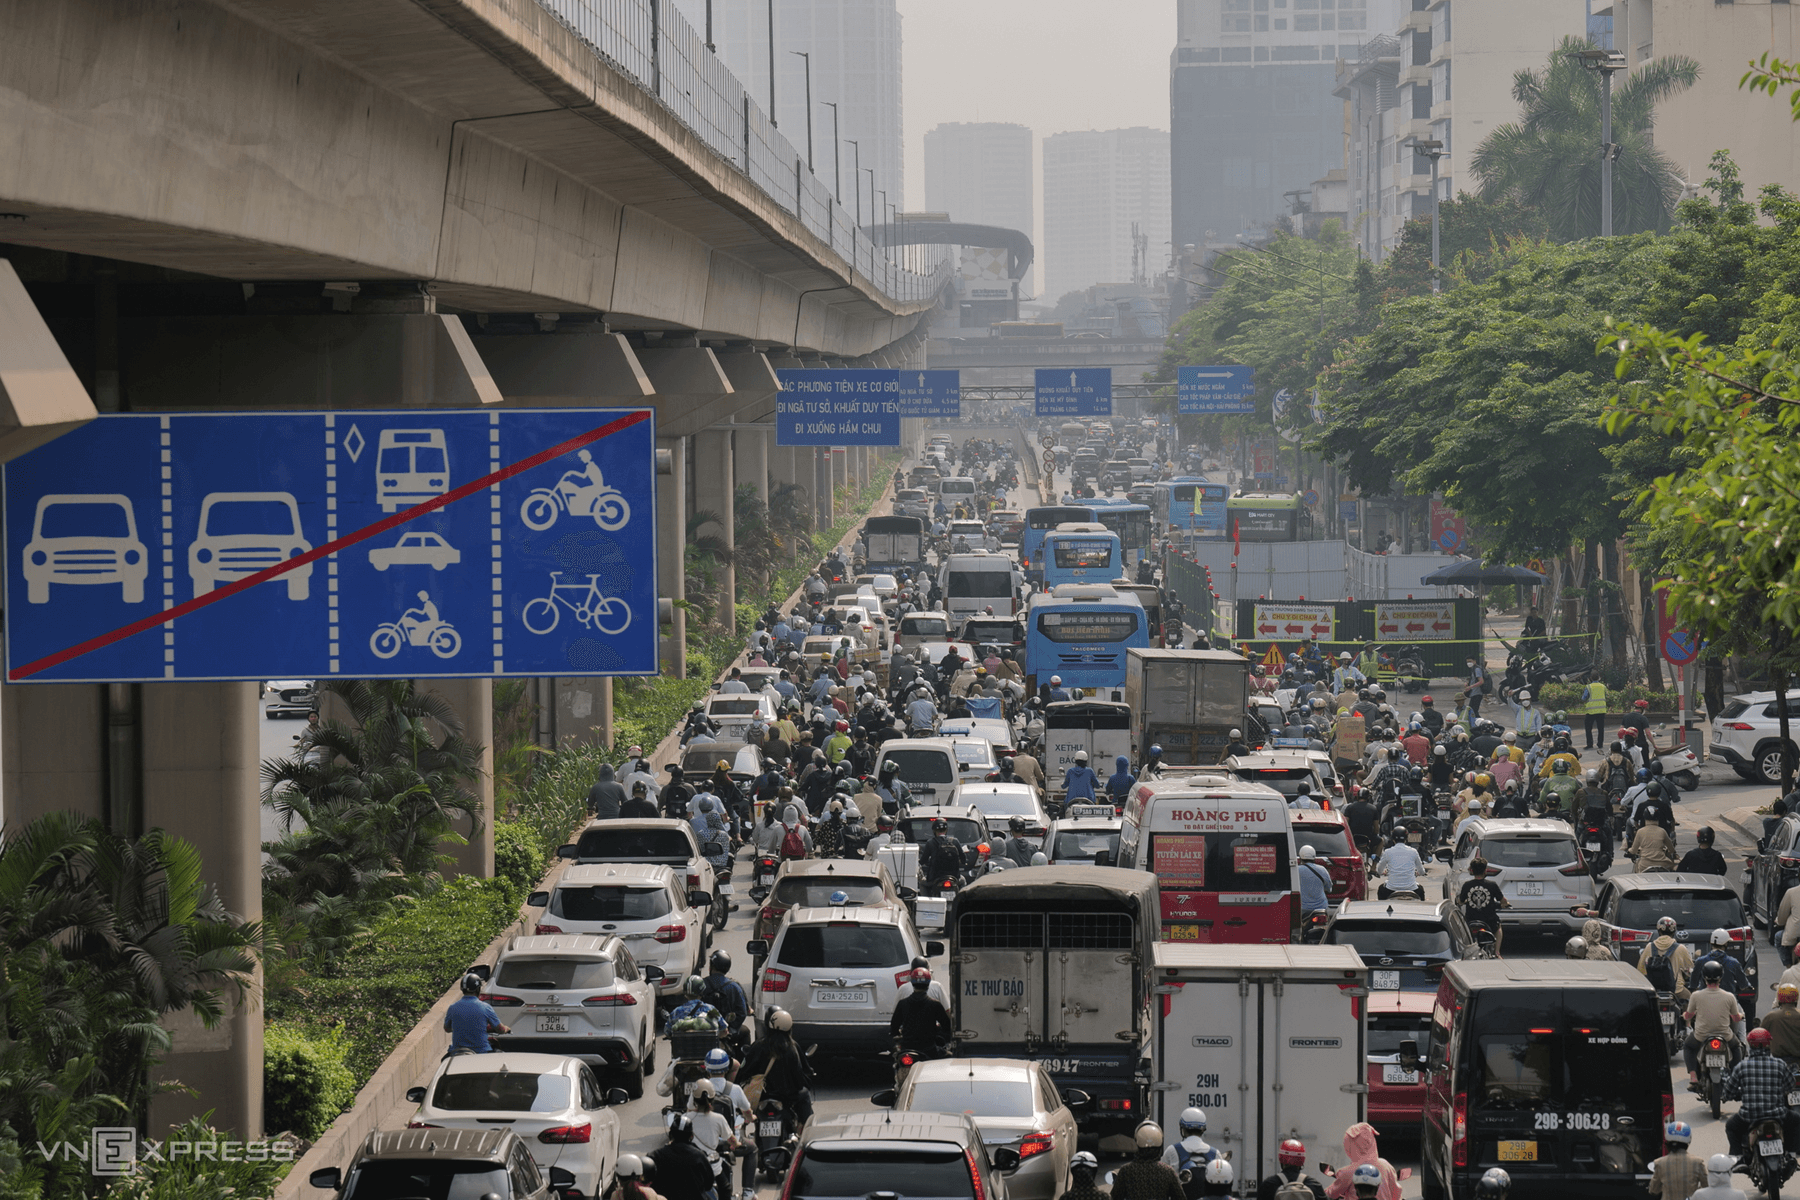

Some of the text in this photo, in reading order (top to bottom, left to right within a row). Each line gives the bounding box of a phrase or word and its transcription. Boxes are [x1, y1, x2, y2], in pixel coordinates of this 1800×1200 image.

[797, 381, 832, 393] PHƯƠNG
[835, 379, 854, 394] TIỆN
[856, 382, 868, 393] XE
[870, 381, 882, 393] CƠ
[884, 378, 899, 393] GIỚI
[778, 398, 899, 414] ĐI NGÃ TƯ SỞ, KHUẤT DUY TIẾN
[795, 419, 881, 434] ĐI XUỐNG HẦM CHUI
[1169, 735, 1185, 744] 29H
[1171, 807, 1267, 823] HOÀNG PHÚ
[1156, 847, 1179, 859] TUYỂN
[1193, 851, 1202, 859] XE
[1379, 971, 1393, 980] 30F
[965, 977, 1024, 996] XE THƯ BÁO
[1374, 980, 1399, 989] 848.75
[822, 992, 864, 1001] 29A-252.60
[546, 1016, 560, 1024] 30H
[1197, 1074, 1219, 1088] 29H
[1387, 1074, 1415, 1082] 968.56
[1189, 1093, 1227, 1108] 590.01
[1566, 1113, 1610, 1129] 306.28
[1509, 1142, 1526, 1150] 29B
